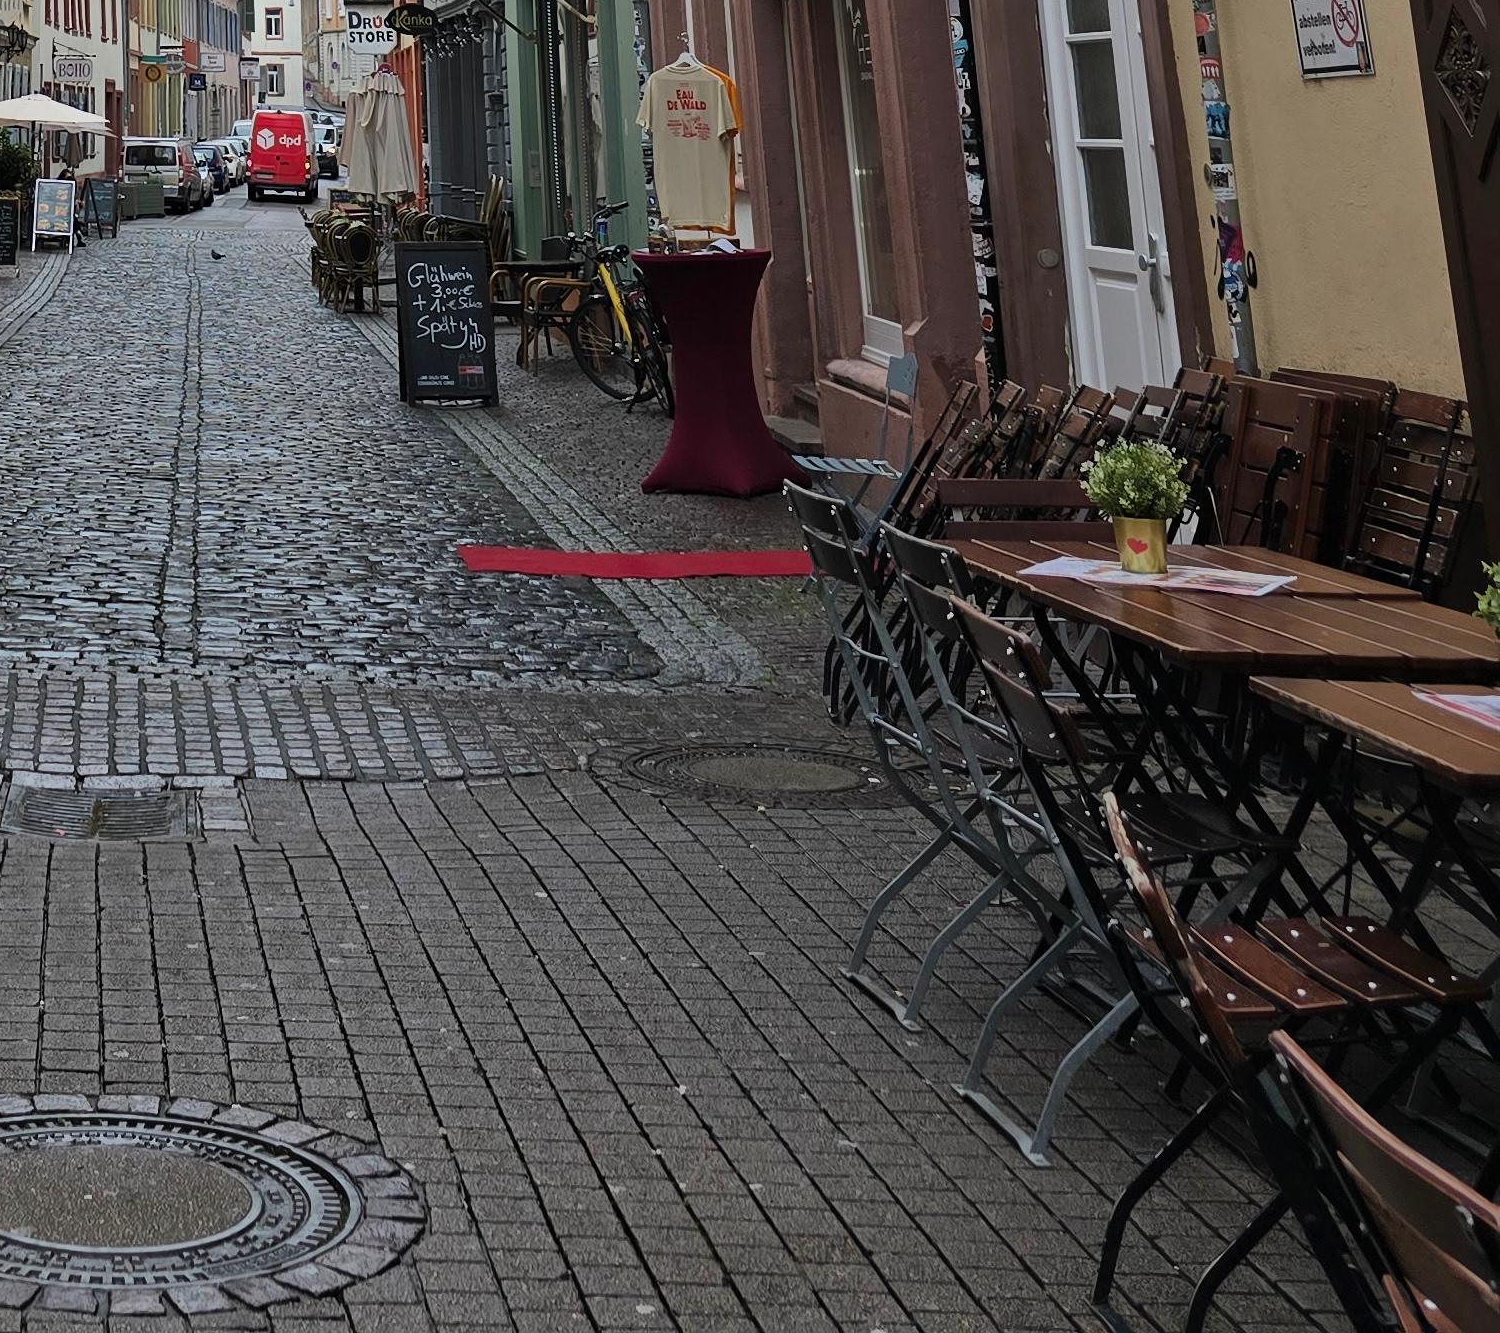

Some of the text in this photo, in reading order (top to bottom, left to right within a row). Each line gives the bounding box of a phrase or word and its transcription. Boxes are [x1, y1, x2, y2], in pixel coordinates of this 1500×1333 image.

[1299, 12, 1332, 29] abstellen
[349, 31, 394, 43] STORE
[59, 63, 91, 78] BOHO
[676, 89, 694, 100] EAU
[667, 99, 707, 110] DE WALD
[279, 134, 301, 148] dpd
[407, 262, 473, 288] Glühwein
